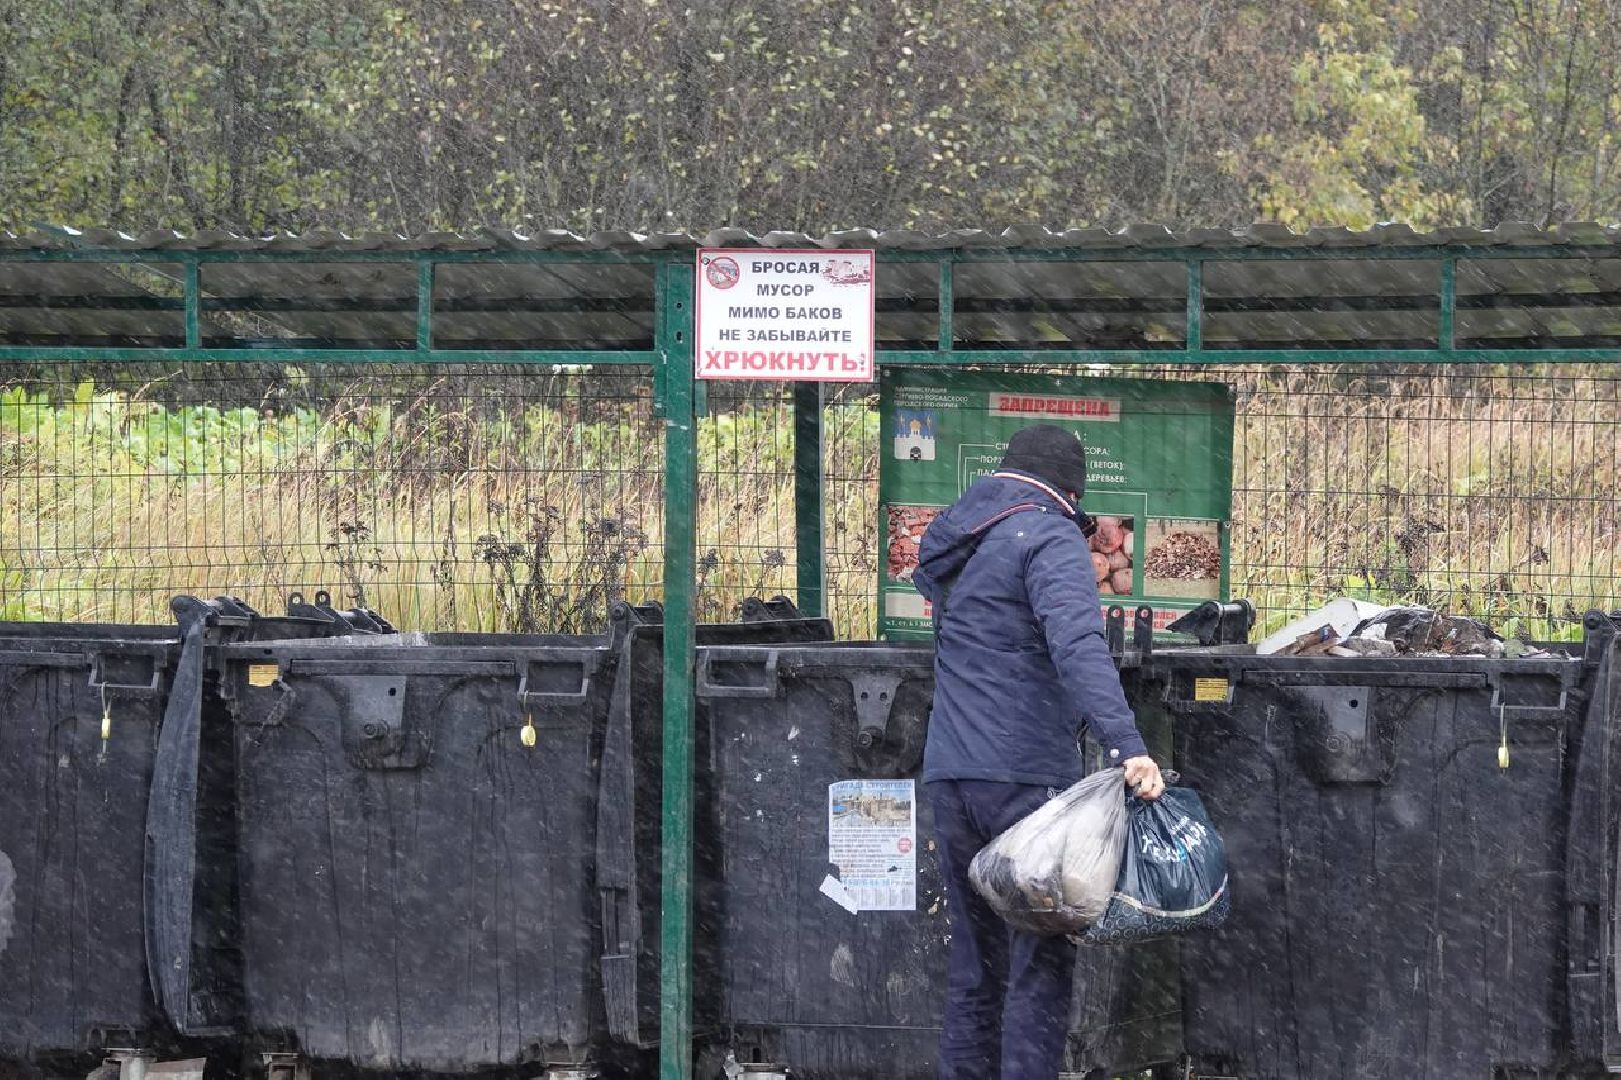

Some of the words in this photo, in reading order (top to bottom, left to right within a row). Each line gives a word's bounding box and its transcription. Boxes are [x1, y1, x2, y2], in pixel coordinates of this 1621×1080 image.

[752, 261, 820, 274] БРОСАЯ
[757, 284, 815, 296] МУСОР
[728, 306, 781, 319] МИМО
[785, 307, 843, 320] БАКОВ
[719, 329, 741, 341] НЕ
[747, 328, 852, 342] ЗАБЫВАЙТЕ
[999, 397, 1110, 416] ЗАПРЕЩЕНА
